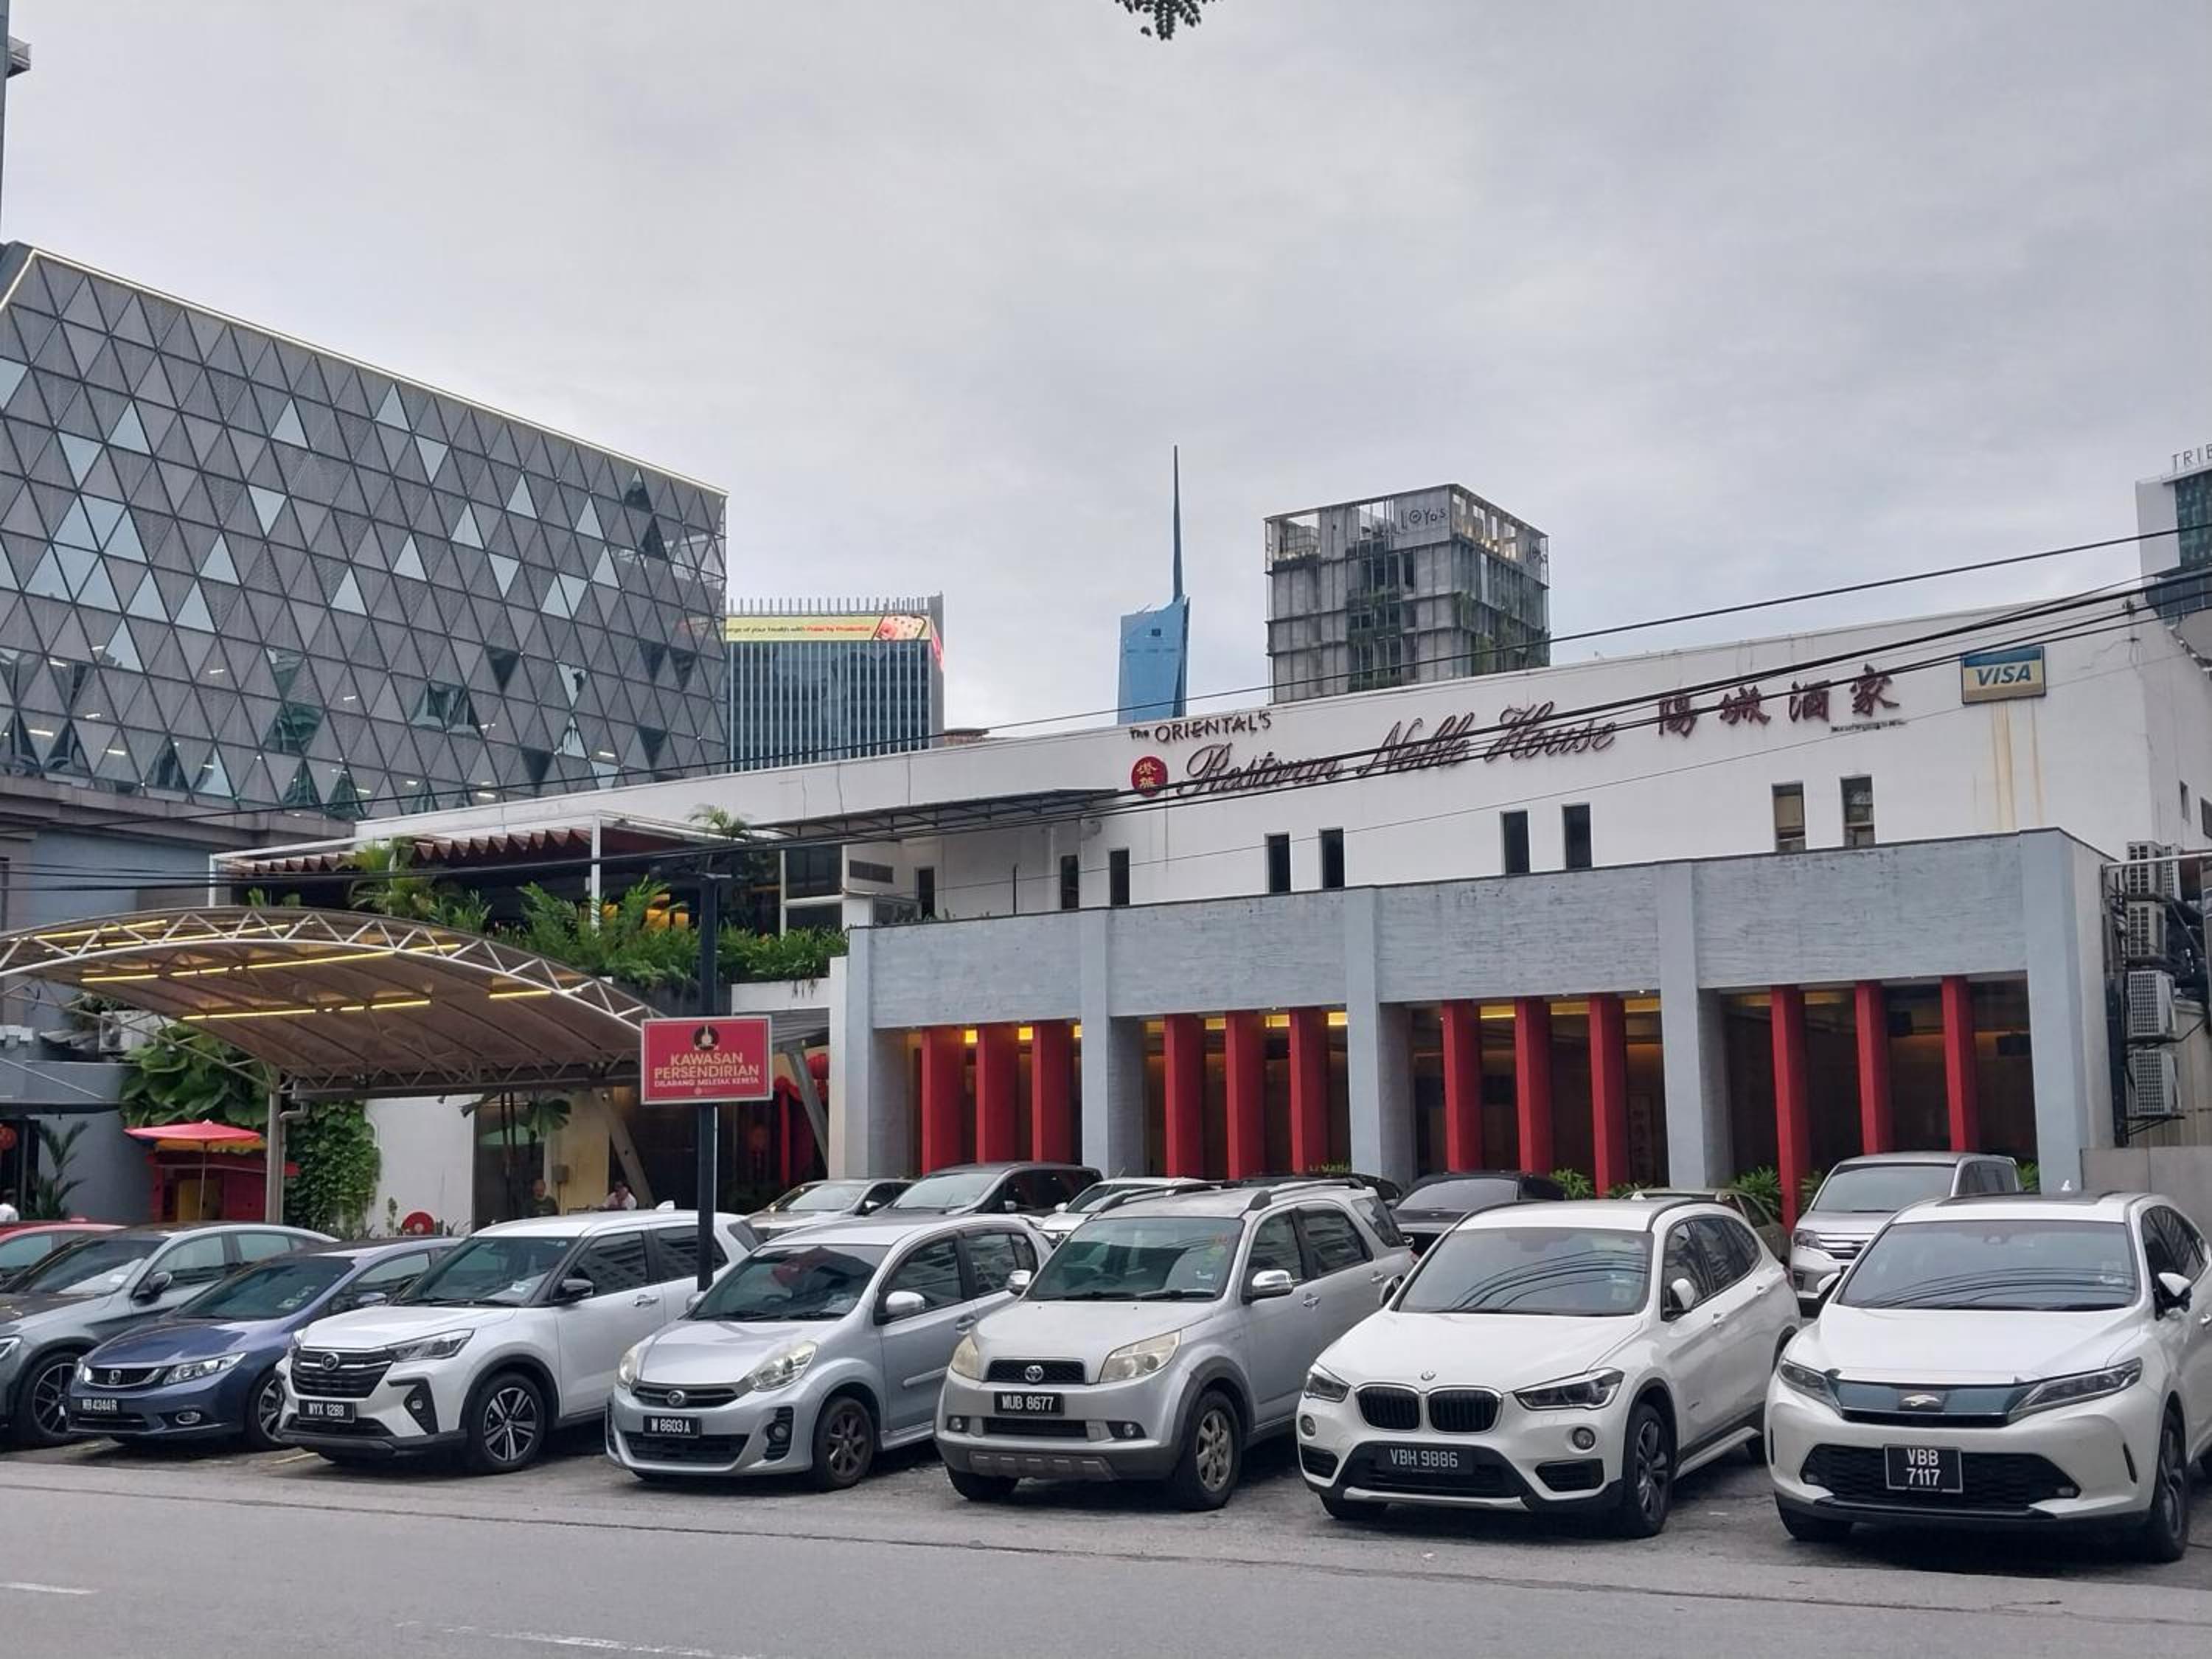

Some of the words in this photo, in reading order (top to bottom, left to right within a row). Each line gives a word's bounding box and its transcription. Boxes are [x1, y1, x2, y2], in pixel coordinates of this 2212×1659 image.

[1977, 664, 2031, 686] VISA
[1155, 710, 1272, 742] ORIENTAL'S
[670, 1052, 743, 1066] KAWASAN
[654, 1065, 759, 1079] PERSENDIRIAN
[1026, 1396, 1054, 1411] 8677
[1390, 1448, 1417, 1467] VBH
[1420, 1450, 1458, 1468] 9886
[1907, 1447, 1939, 1467] VBB
[1906, 1467, 1941, 1486] 7117
